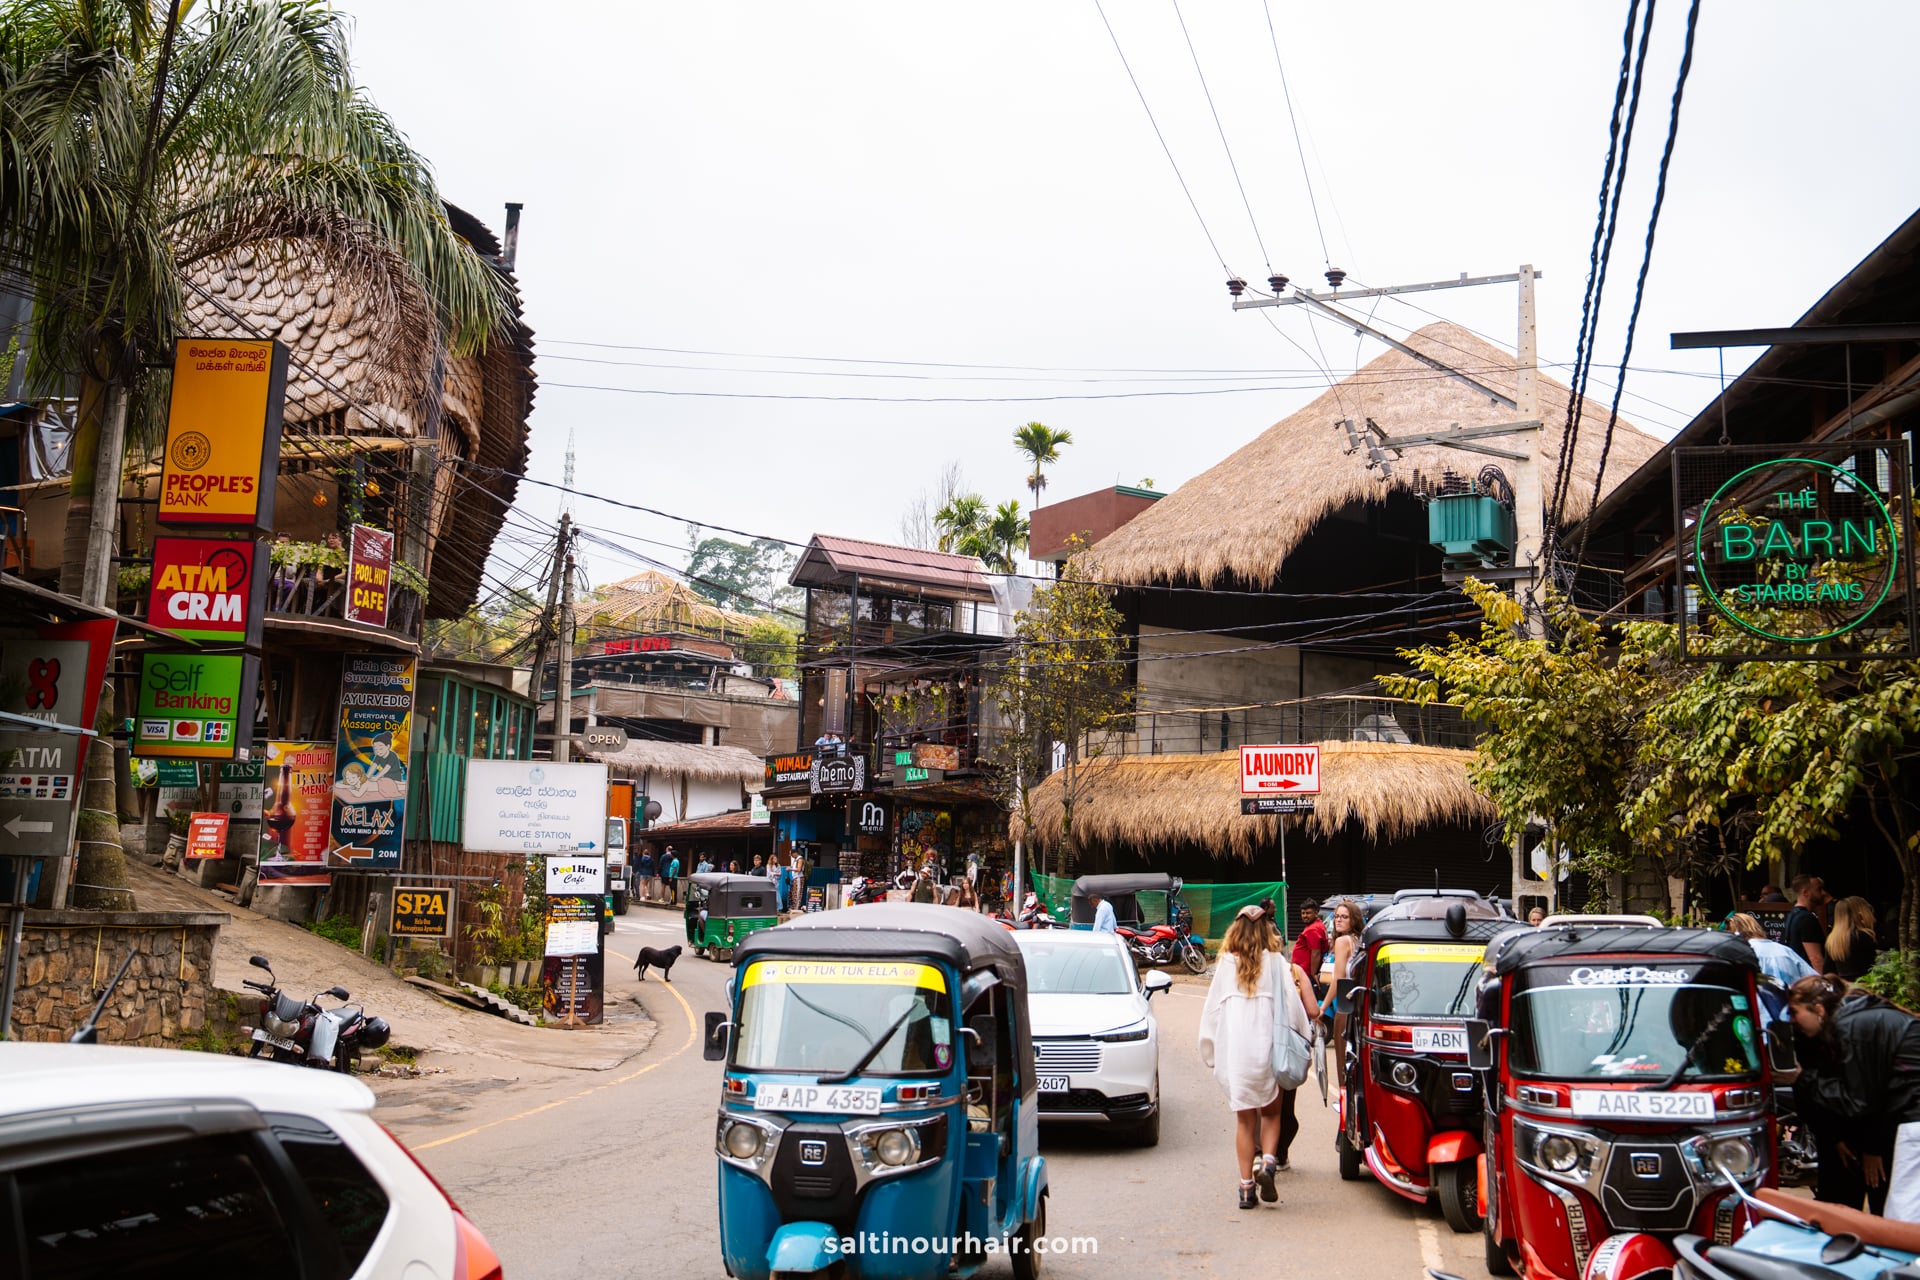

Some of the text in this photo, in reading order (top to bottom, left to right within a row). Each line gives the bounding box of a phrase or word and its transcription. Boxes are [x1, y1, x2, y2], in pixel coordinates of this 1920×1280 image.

[189, 347, 267, 361] මහජන බැංකුව
[196, 361, 266, 373] மக்கள் வங்கி
[167, 474, 254, 494] PEOPLE'S
[165, 491, 208, 507] BANK
[1774, 490, 1817, 509] THE
[1724, 519, 1876, 560] BARN
[156, 564, 227, 592] ATM
[355, 563, 387, 586] POOL HUT
[1786, 563, 1808, 580] BY
[353, 587, 385, 612] CAFE
[1738, 583, 1864, 602] STARBEANS
[167, 591, 242, 622] CRM
[633, 637, 672, 652] LOVE
[353, 660, 404, 673] Hela Osu
[148, 662, 204, 692] Self
[344, 672, 411, 687] Suwapiyasa
[154, 690, 231, 715] Banking
[341, 692, 411, 708] AYURVEDIC
[354, 712, 387, 720] EVERYDAY
[146, 725, 165, 734] VISA
[204, 728, 228, 736] JCB
[340, 719, 382, 732] Massage
[384, 719, 402, 735] Day
[588, 734, 621, 745] OPEN
[9, 747, 62, 768] ATM
[296, 752, 332, 766] POOL HUT
[775, 755, 812, 772] WIMALA
[1245, 753, 1315, 776] LAUNDRY
[296, 772, 327, 785] BAR
[301, 783, 329, 795] MENU
[340, 805, 394, 828] RELAX
[499, 829, 572, 840] POLICE STATION
[378, 850, 398, 858] 20M
[551, 865, 598, 876] Pool Hut
[396, 892, 446, 915] SPA
[784, 965, 810, 975] CITY
[813, 965, 837, 976] TUK
[841, 965, 864, 976] TUK
[867, 966, 898, 977] ELLA
[1416, 1032, 1462, 1047] UP ABN
[757, 1087, 879, 1111] UP AAP 4335
[1598, 1094, 1708, 1115] AAR 5220
[803, 1148, 822, 1160] RE
[1636, 1160, 1657, 1173] RE
